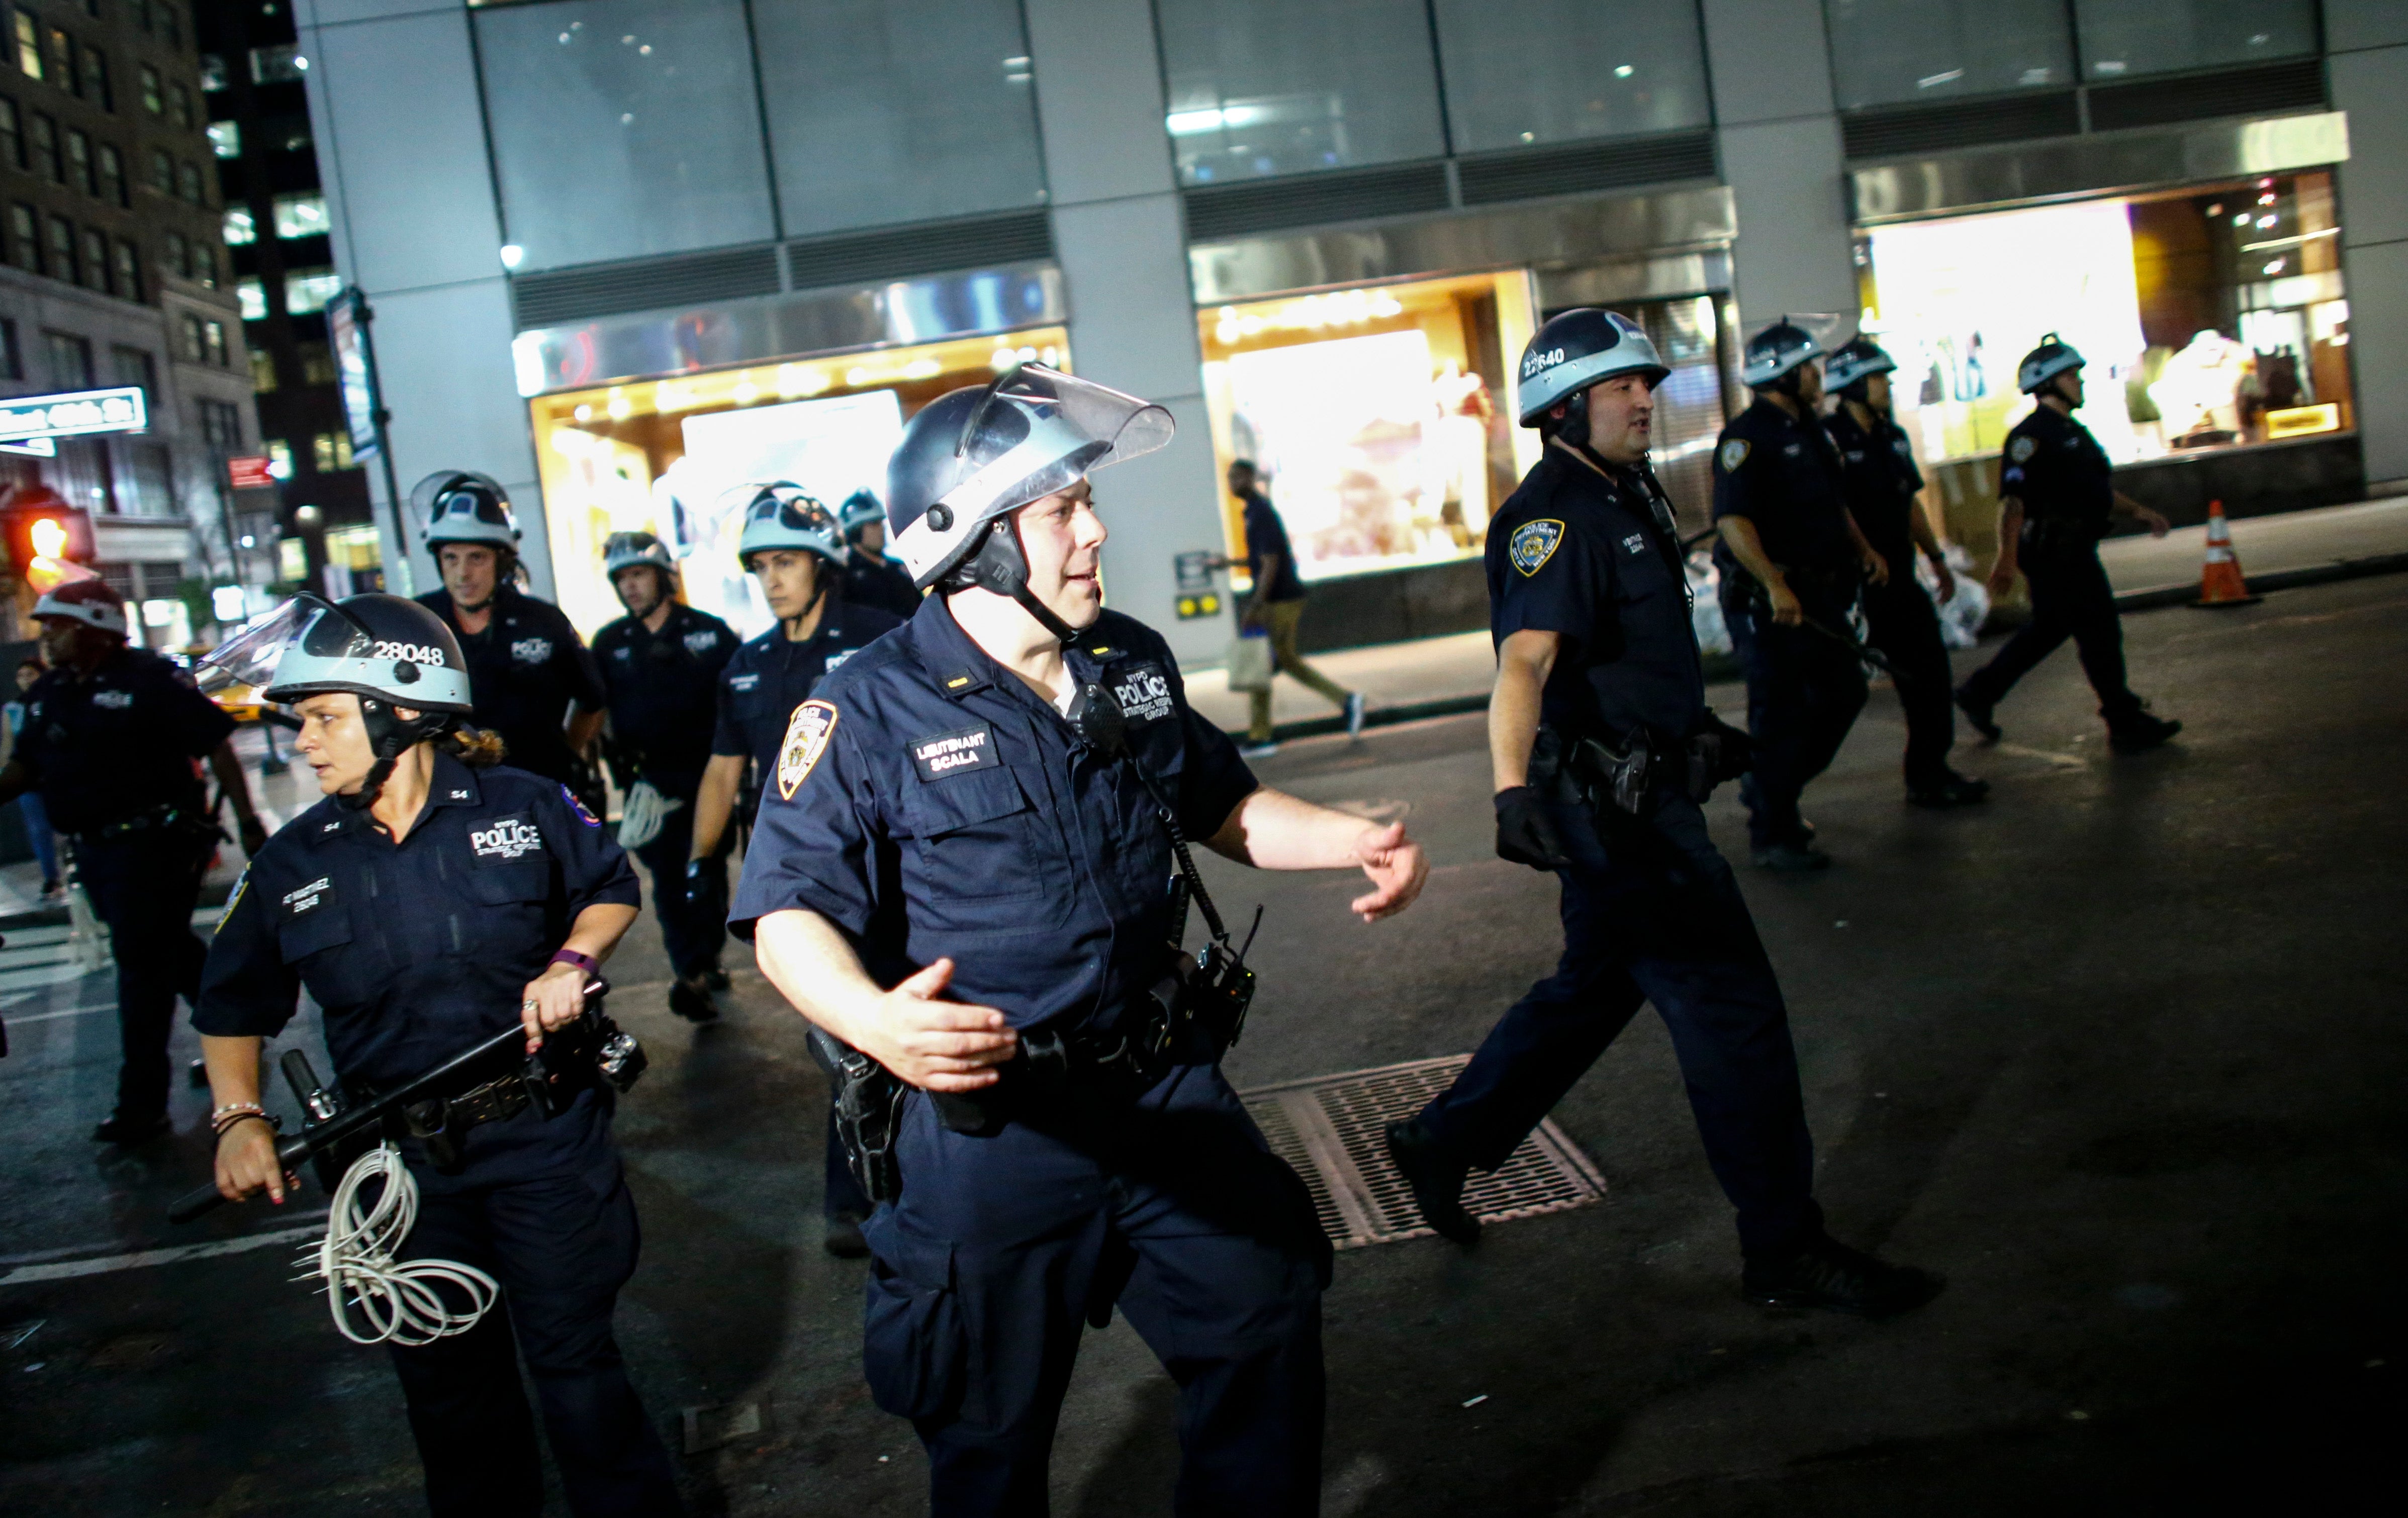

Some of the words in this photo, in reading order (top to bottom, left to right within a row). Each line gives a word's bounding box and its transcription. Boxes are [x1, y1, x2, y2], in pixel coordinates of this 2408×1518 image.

[374, 641, 444, 667] 28048
[1126, 671, 1148, 684] NYPD
[1123, 701, 1155, 718] STRATEGIC
[1145, 706, 1169, 721] GROUP
[916, 732, 985, 760] LIEUTENANT
[931, 750, 979, 772] SCALA
[471, 825, 541, 849] POLICE
